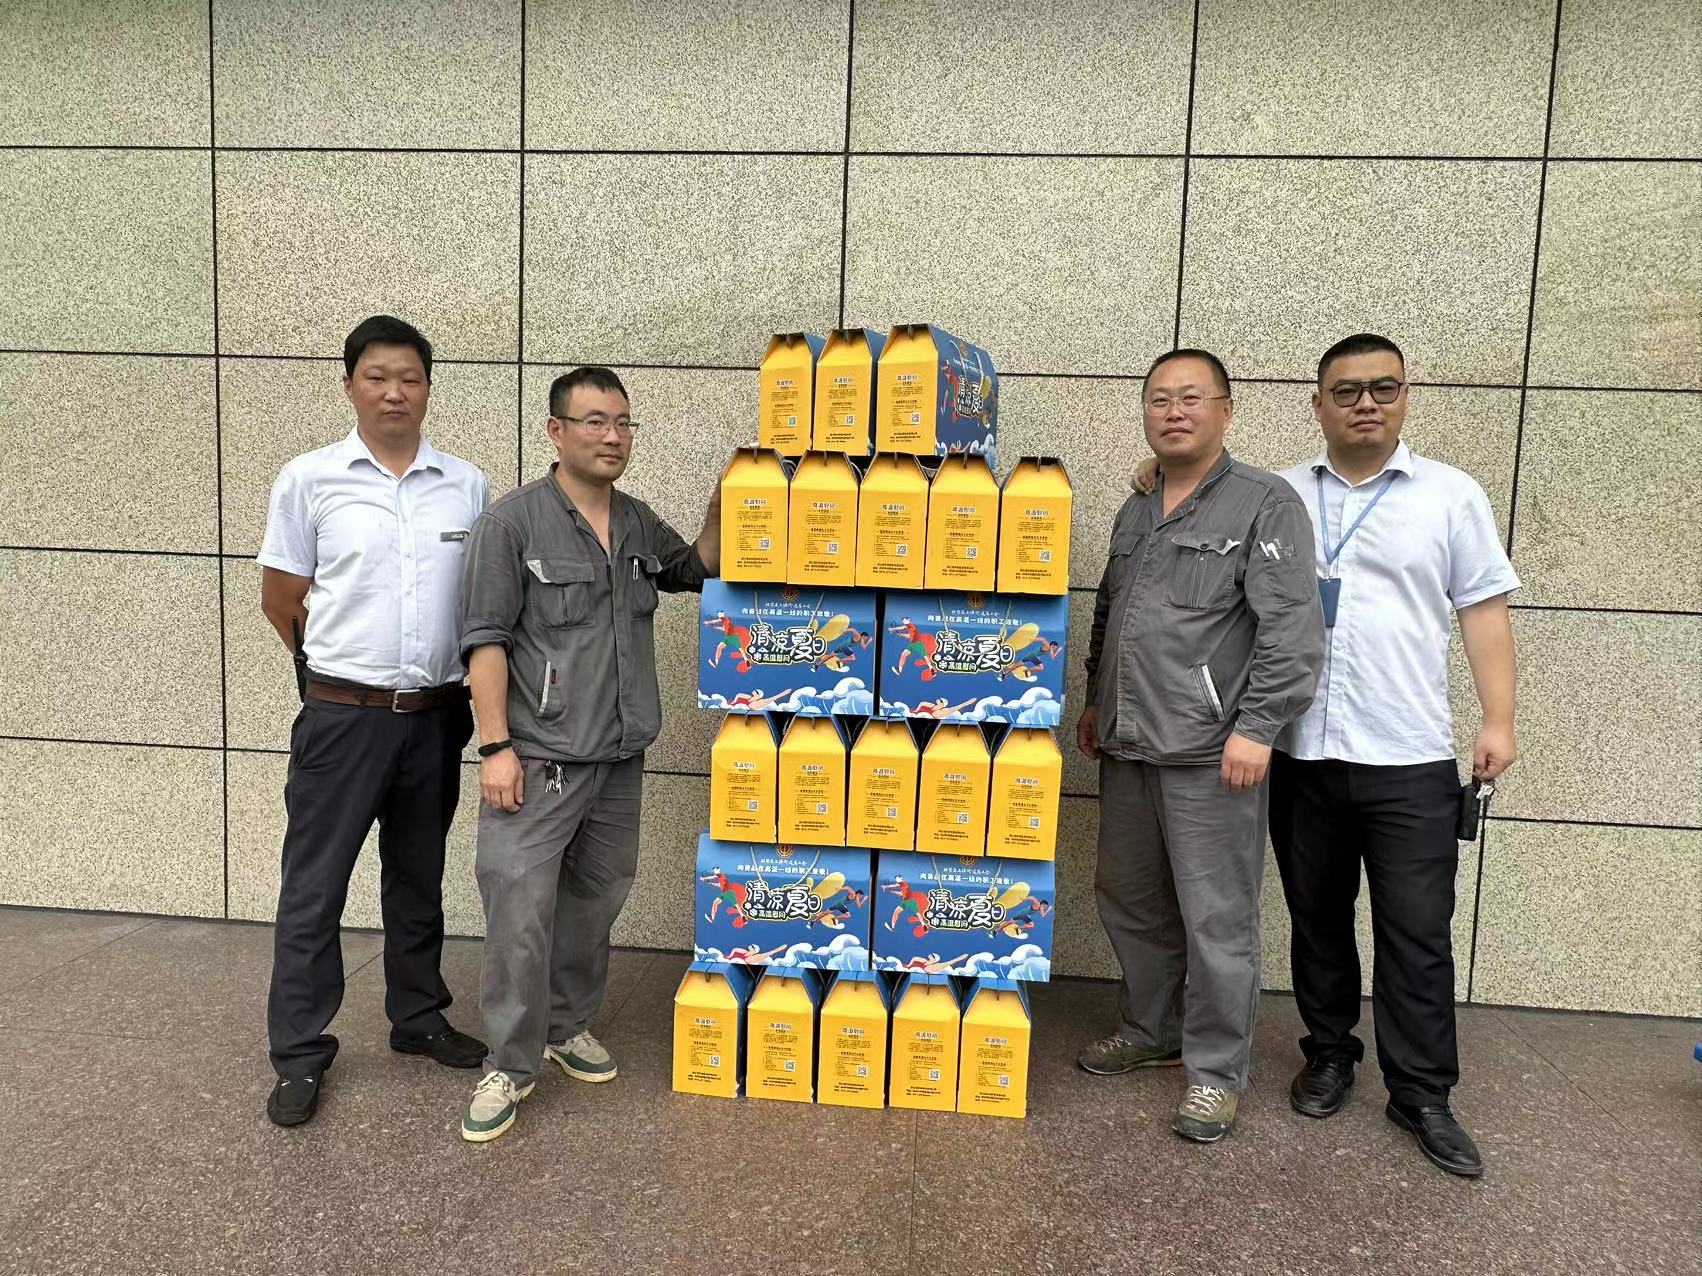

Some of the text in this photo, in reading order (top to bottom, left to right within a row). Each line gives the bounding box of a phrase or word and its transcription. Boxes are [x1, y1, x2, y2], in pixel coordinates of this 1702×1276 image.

[752, 625, 825, 661] 清凉夏日
[937, 631, 1013, 668] 清凉夏日
[762, 654, 790, 662] 高温慰问
[947, 661, 977, 671] 高温慰问
[747, 881, 821, 916] 清凉夏日
[929, 890, 1004, 927] 清凉夏日
[758, 910, 786, 918] 高温慰问
[939, 919, 968, 928] 高温慰问
